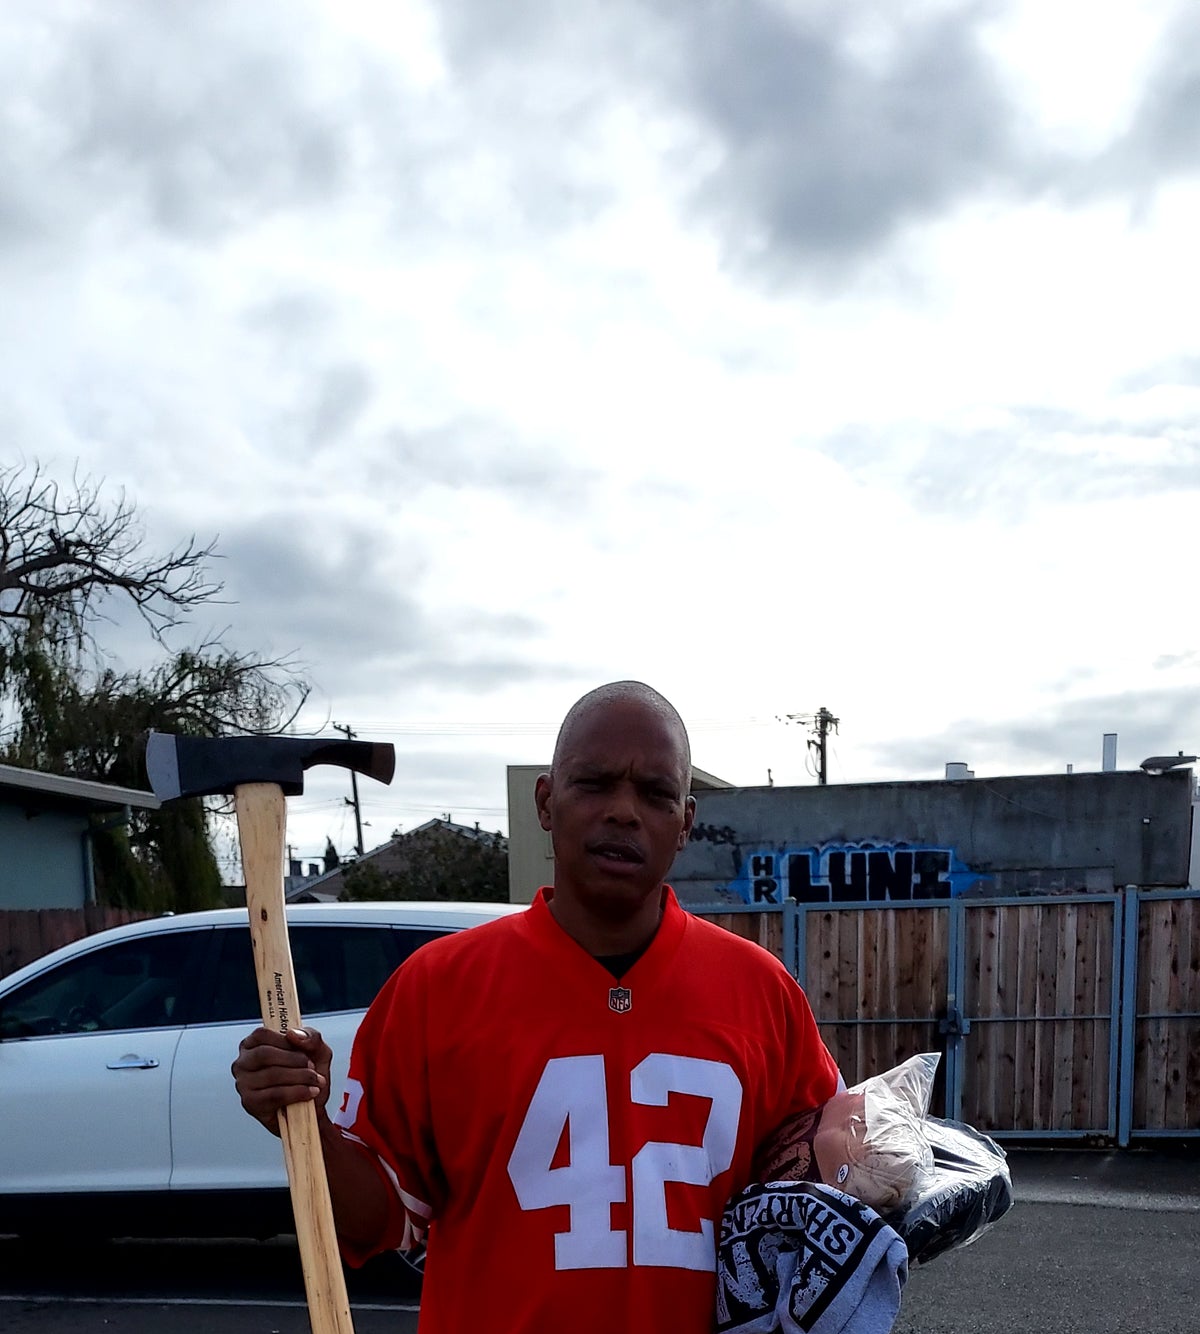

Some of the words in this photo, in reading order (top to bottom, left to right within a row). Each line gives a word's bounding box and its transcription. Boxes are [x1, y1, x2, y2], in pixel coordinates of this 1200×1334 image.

[274, 972, 285, 1006] American
[279, 1007, 288, 1035] Hickory
[507, 1053, 743, 1272] 42
